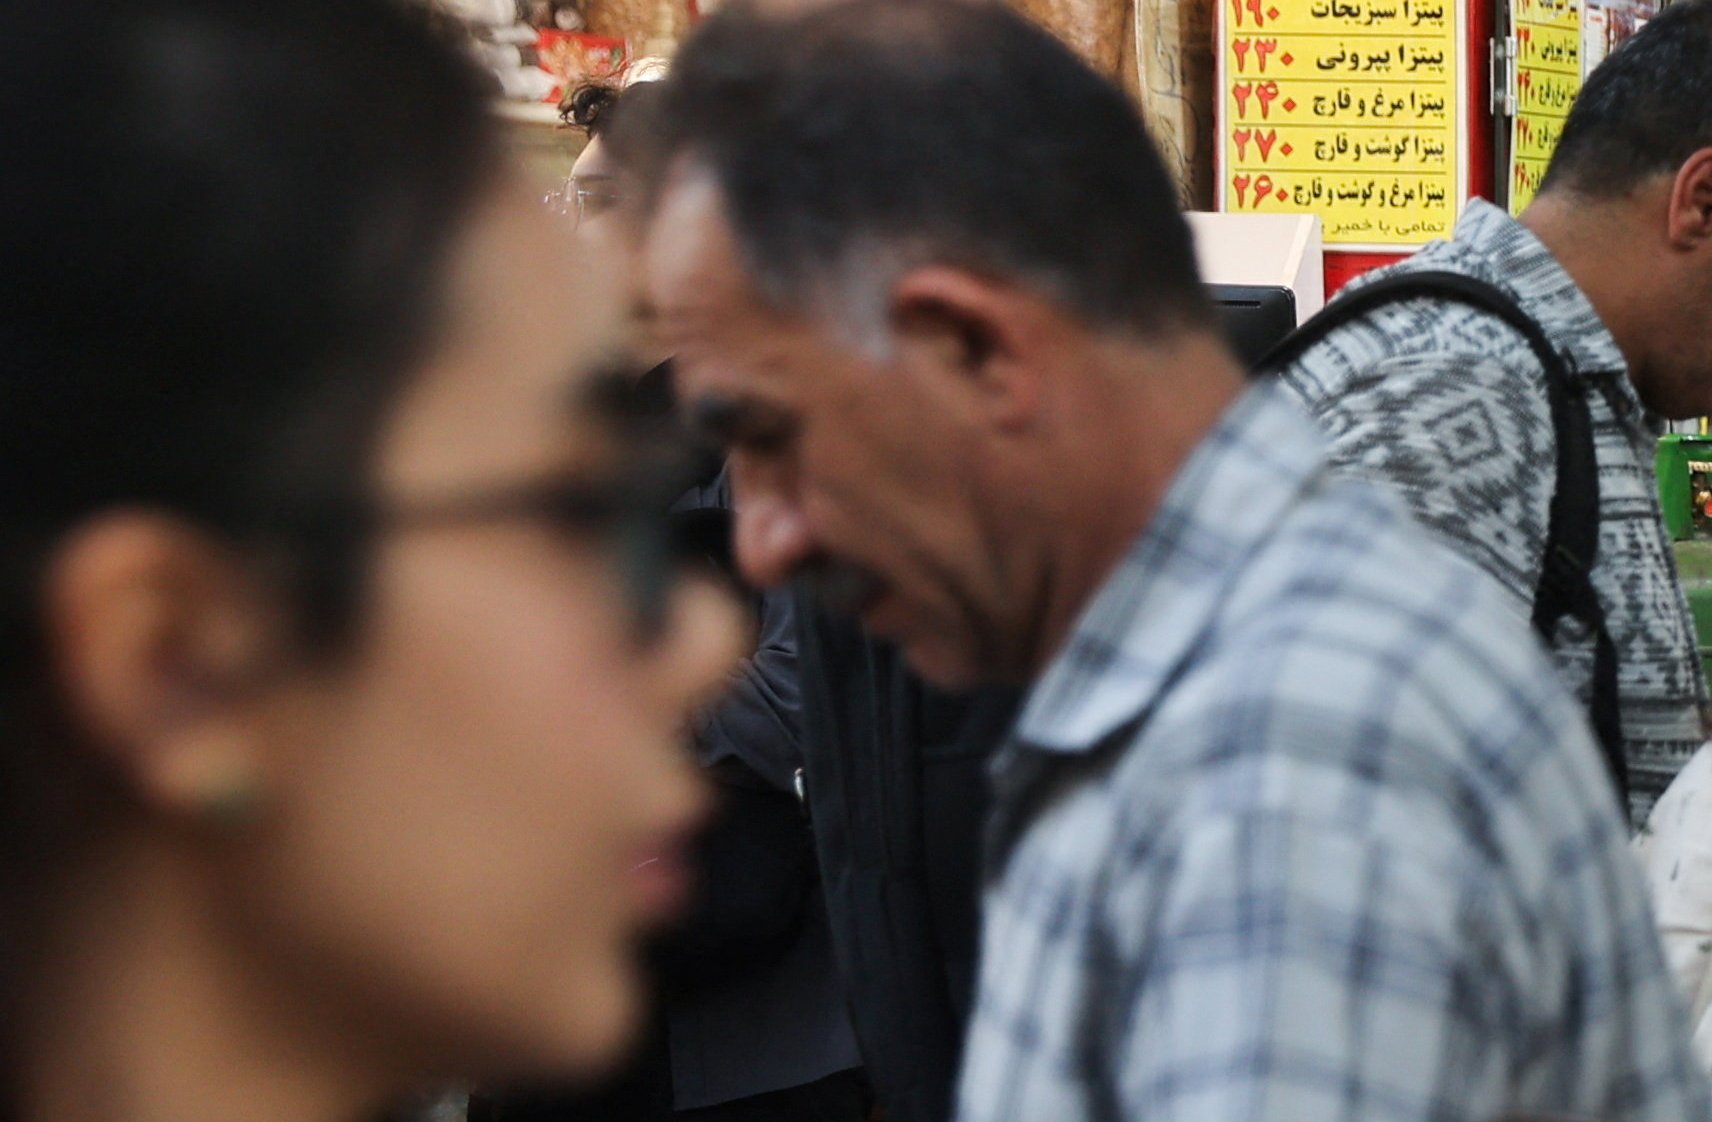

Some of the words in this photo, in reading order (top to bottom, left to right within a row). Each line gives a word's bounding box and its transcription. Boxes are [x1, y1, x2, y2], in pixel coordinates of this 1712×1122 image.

[1404, 0, 1444, 27] پیتزا
[1232, 38, 1295, 74] ۲۳۰
[1316, 43, 1391, 72] پپرونی
[1398, 44, 1444, 73] پیتزا
[1232, 80, 1297, 120] ۲۴۰
[1312, 88, 1350, 117] قارچ
[1357, 98, 1366, 117] و
[1373, 88, 1405, 118] مرغ
[1411, 92, 1445, 118] پیتزا
[1232, 129, 1294, 163] ۲۷۰
[1315, 133, 1348, 162] قارچ
[1351, 142, 1361, 161] و
[1366, 133, 1410, 163] گوشت
[1415, 136, 1445, 164] پیتزا
[1232, 175, 1290, 209] ۲۶۰
[1293, 178, 1323, 206] قارچ
[1326, 186, 1334, 206] و
[1337, 177, 1374, 207] گوشت
[1377, 187, 1385, 206] و
[1389, 177, 1414, 206] مرغ
[1418, 181, 1445, 208] پیتزا
[1331, 218, 1373, 236] خمیر
[1378, 219, 1390, 235] با
[1395, 220, 1446, 236] تمامی
